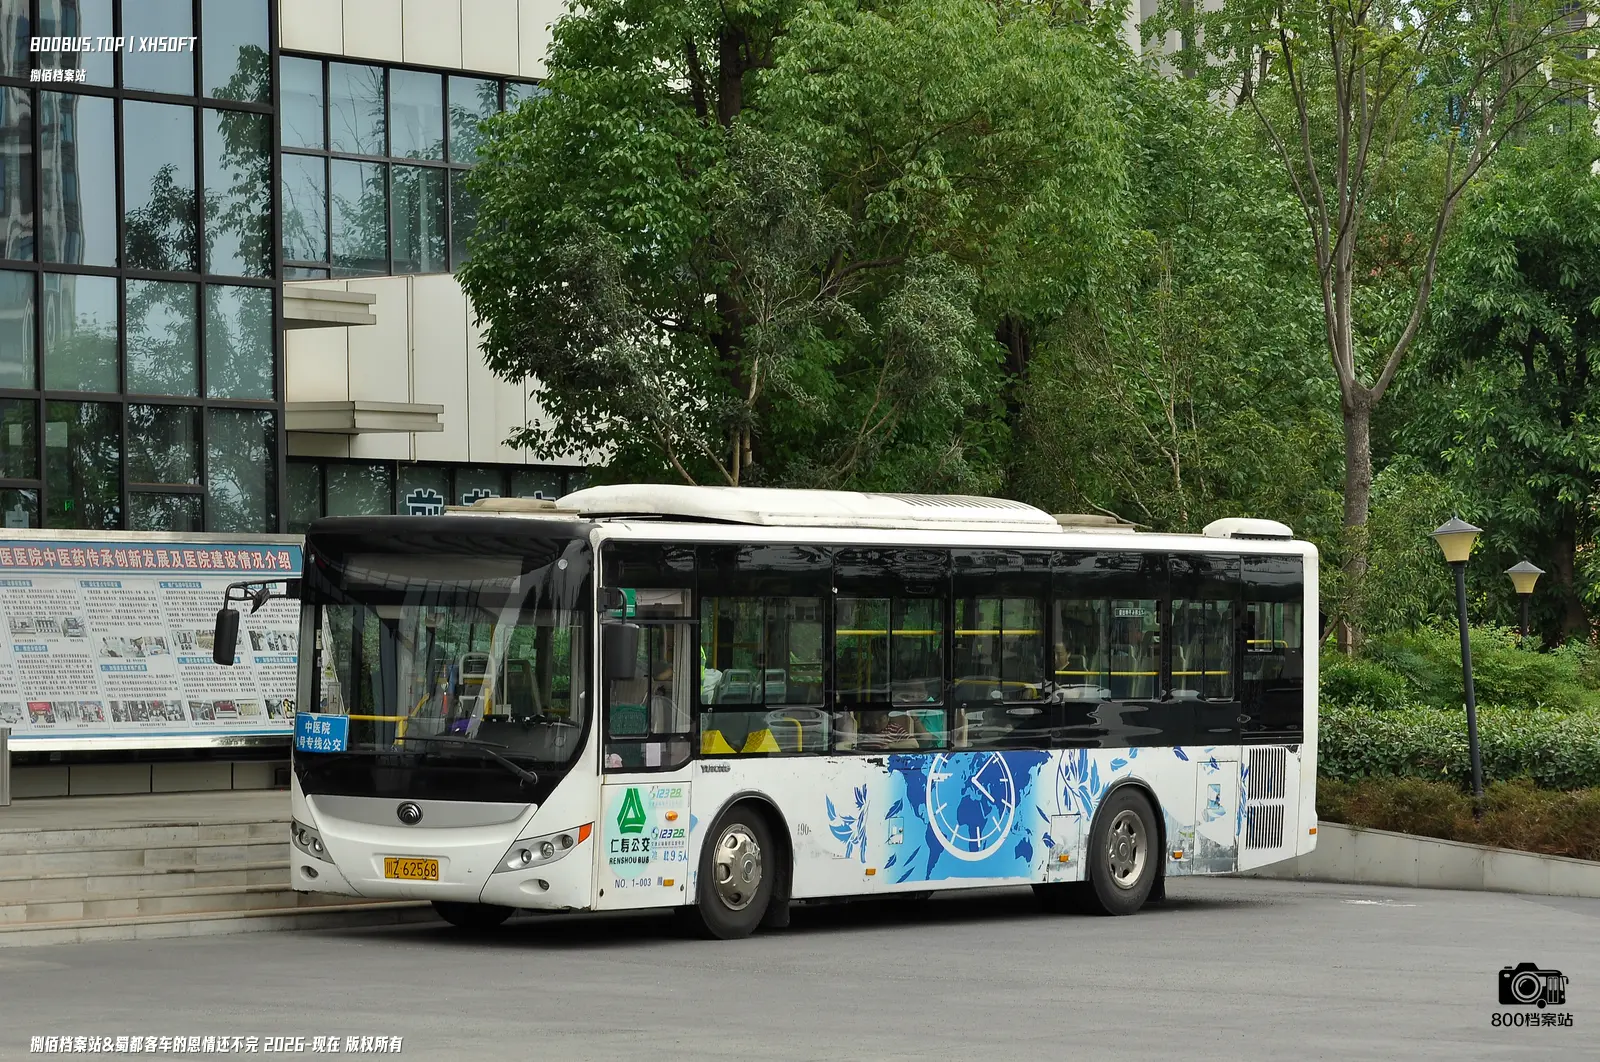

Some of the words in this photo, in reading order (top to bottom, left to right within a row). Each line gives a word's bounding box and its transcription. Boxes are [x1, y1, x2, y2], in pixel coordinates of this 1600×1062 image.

[0, 547, 292, 570] 医医院中医药传承创新发展及医院建设情况介绍
[305, 720, 331, 735] 中医院
[610, 837, 651, 853] 仁寿公交
[631, 877, 652, 887] 1-003
